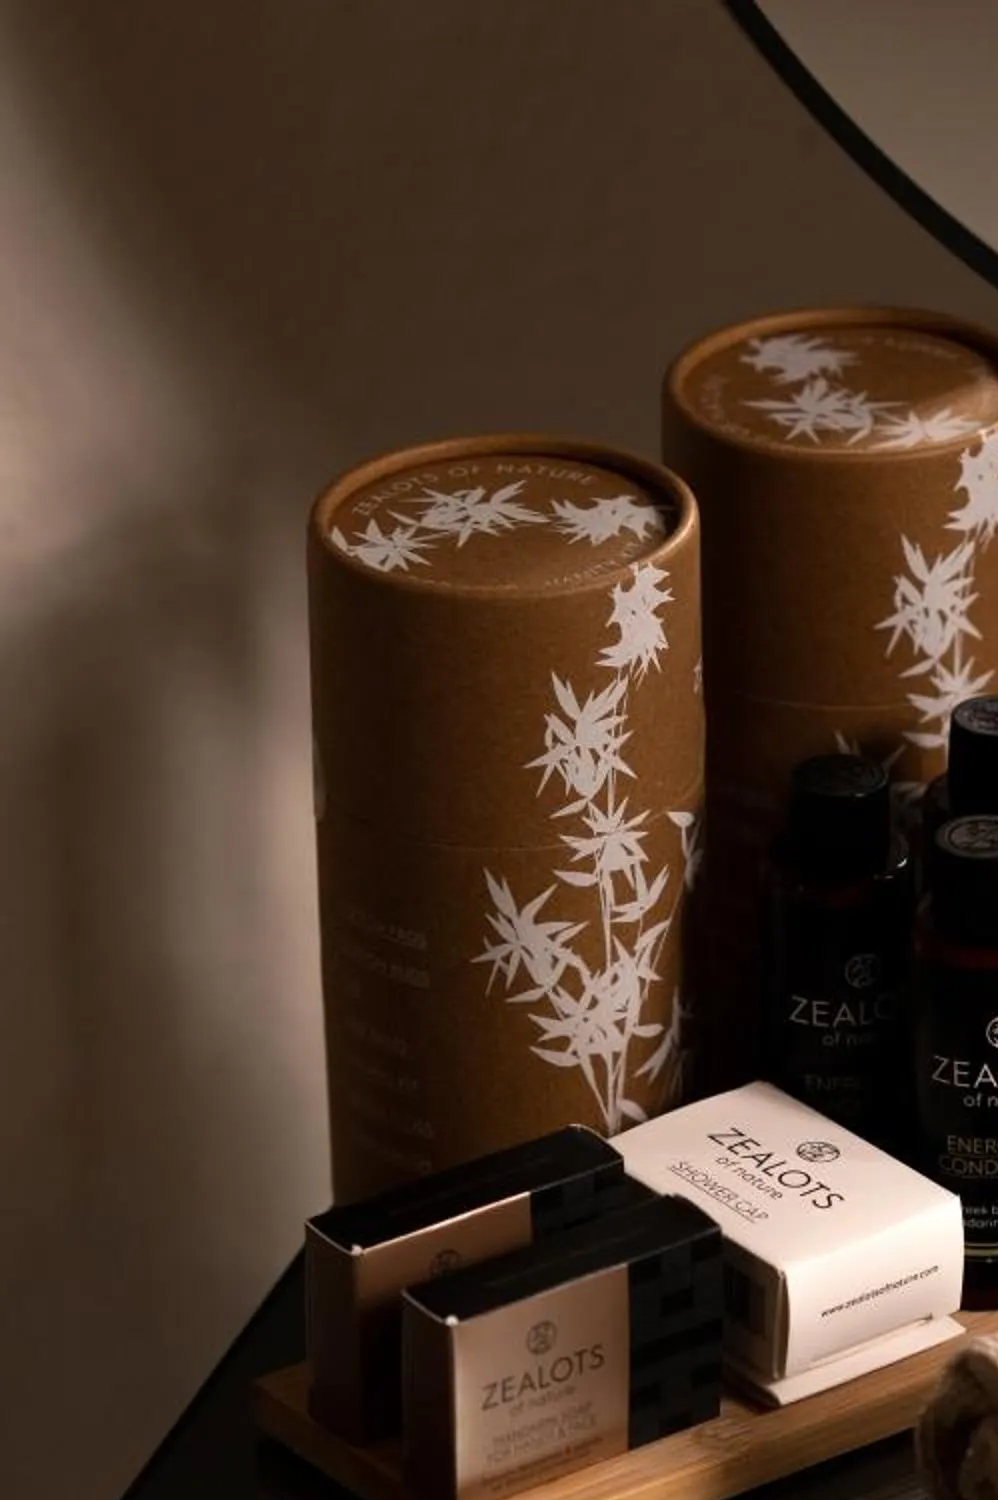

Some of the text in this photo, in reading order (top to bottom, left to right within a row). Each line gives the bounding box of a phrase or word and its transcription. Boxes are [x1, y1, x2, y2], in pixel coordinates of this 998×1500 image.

[962, 1091, 981, 1108] of
[672, 1160, 770, 1221] SHOWER CAP
[706, 1127, 846, 1210] ZEALOTS
[715, 1154, 785, 1201] of nature
[481, 1342, 605, 1411] ZEALOTS
